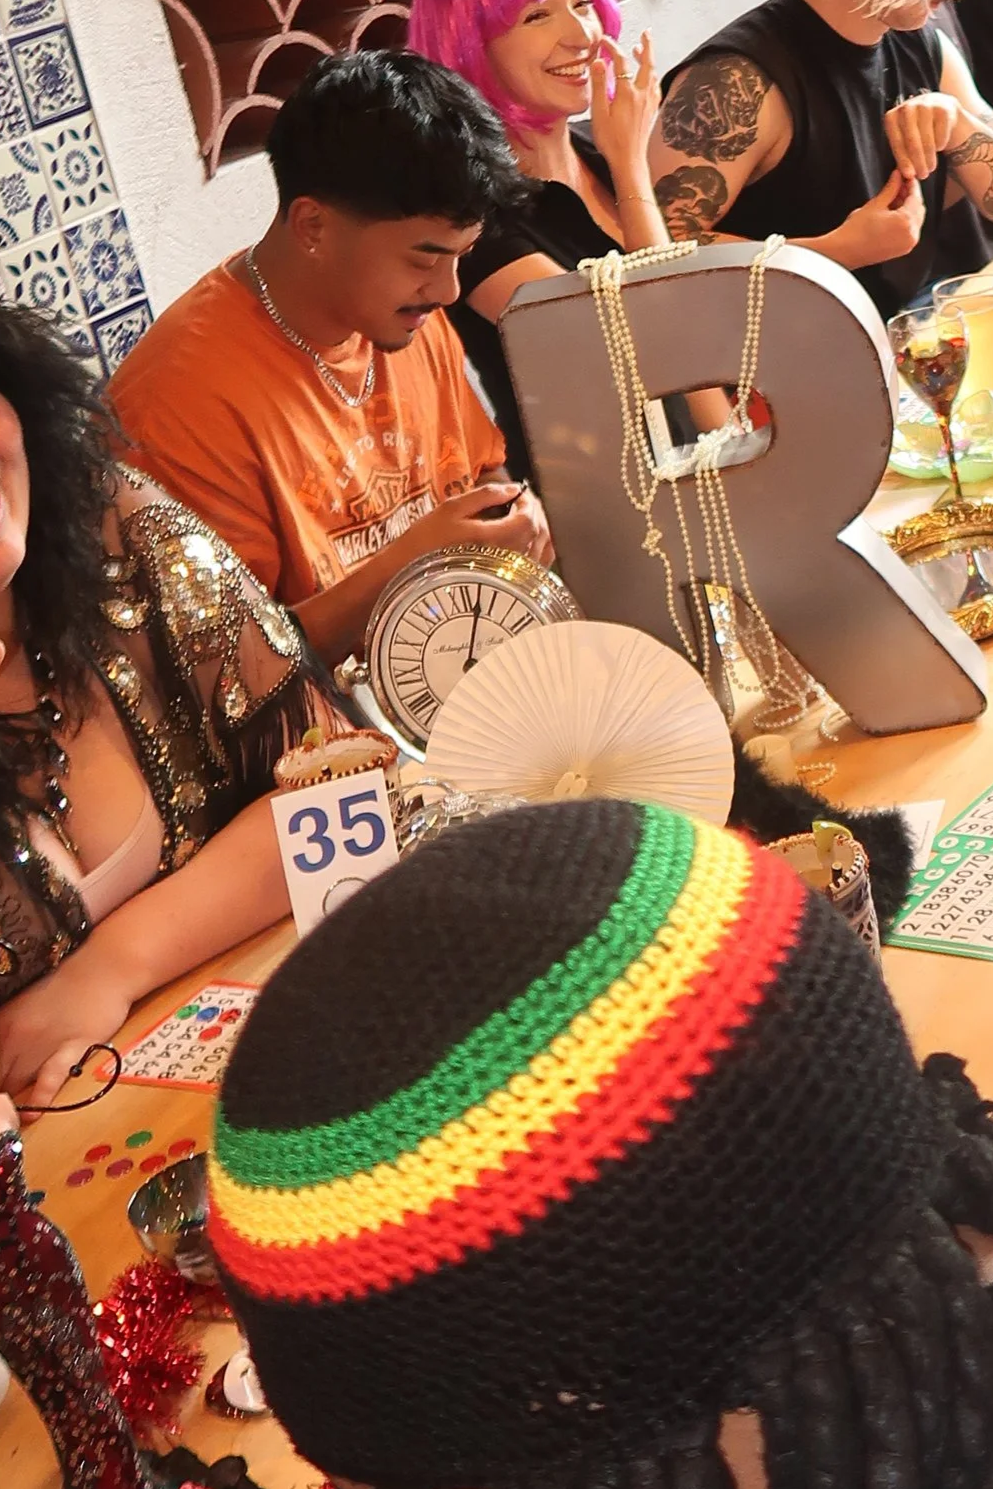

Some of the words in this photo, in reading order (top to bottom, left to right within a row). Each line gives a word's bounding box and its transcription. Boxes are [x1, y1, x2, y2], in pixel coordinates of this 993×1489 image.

[362, 478, 406, 520] MOTO
[288, 789, 386, 874] 35
[952, 822, 978, 833] 67
[968, 809, 993, 820] 71
[901, 923, 920, 931] 2
[915, 903, 941, 915] 18
[932, 887, 957, 901] 38
[951, 870, 973, 884] 60
[964, 854, 989, 868] 70
[924, 923, 951, 935] 12
[941, 905, 963, 921] 27
[960, 890, 983, 904] 43
[950, 927, 975, 939] 11
[967, 910, 993, 924] 28
